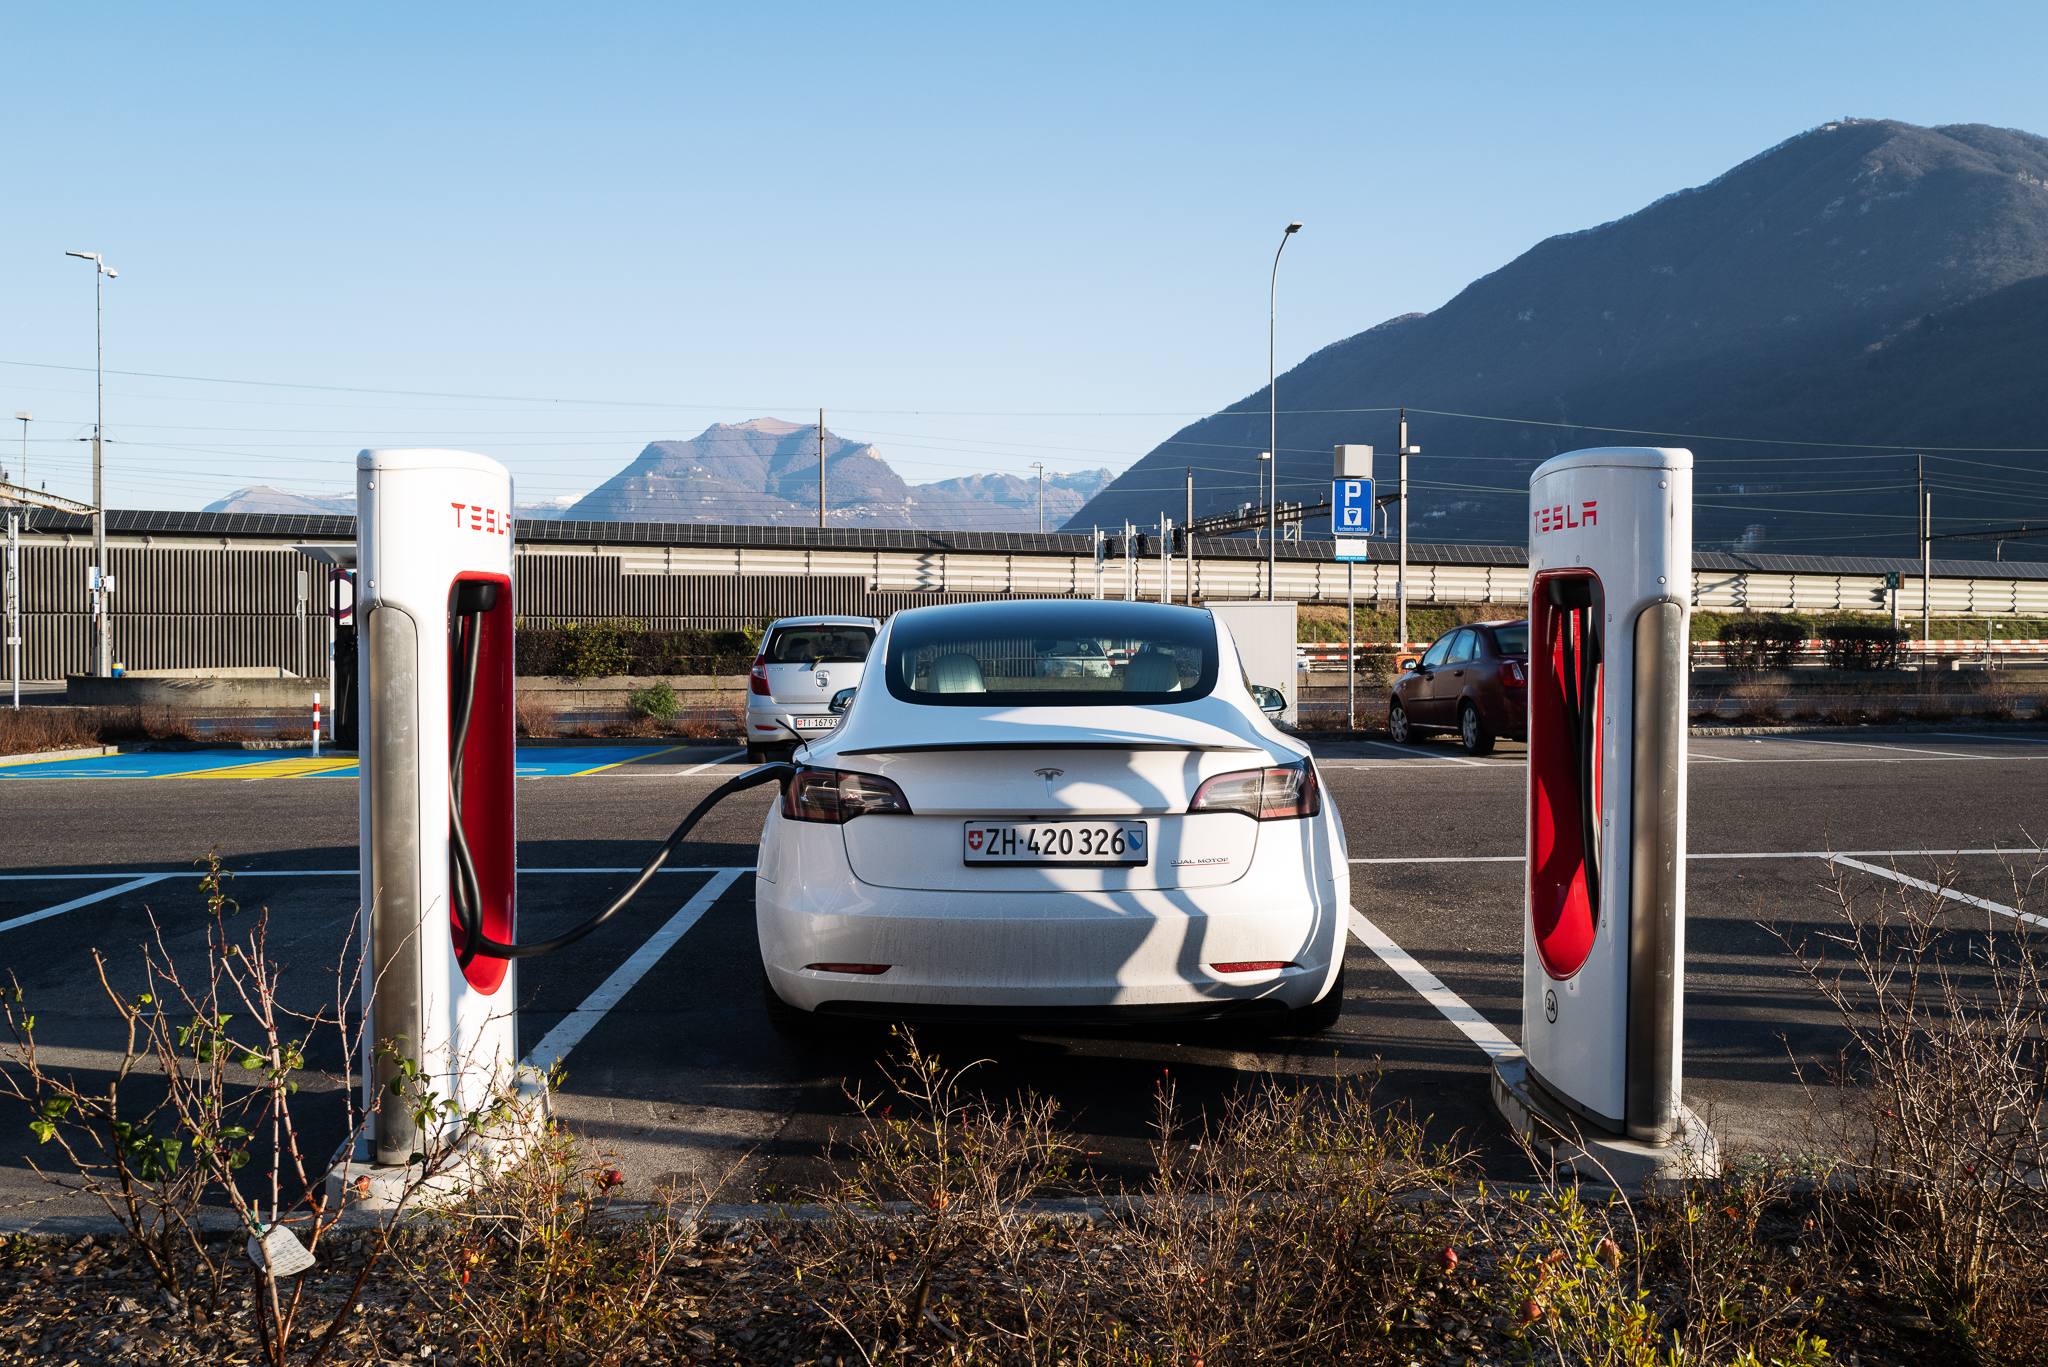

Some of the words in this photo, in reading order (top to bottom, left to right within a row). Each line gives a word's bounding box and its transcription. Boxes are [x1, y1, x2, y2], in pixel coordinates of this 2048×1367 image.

[1344, 481, 1362, 507] P
[451, 502, 511, 537] TESLA
[1533, 500, 1598, 534] TESLA
[1546, 997, 1556, 1015] 3A
